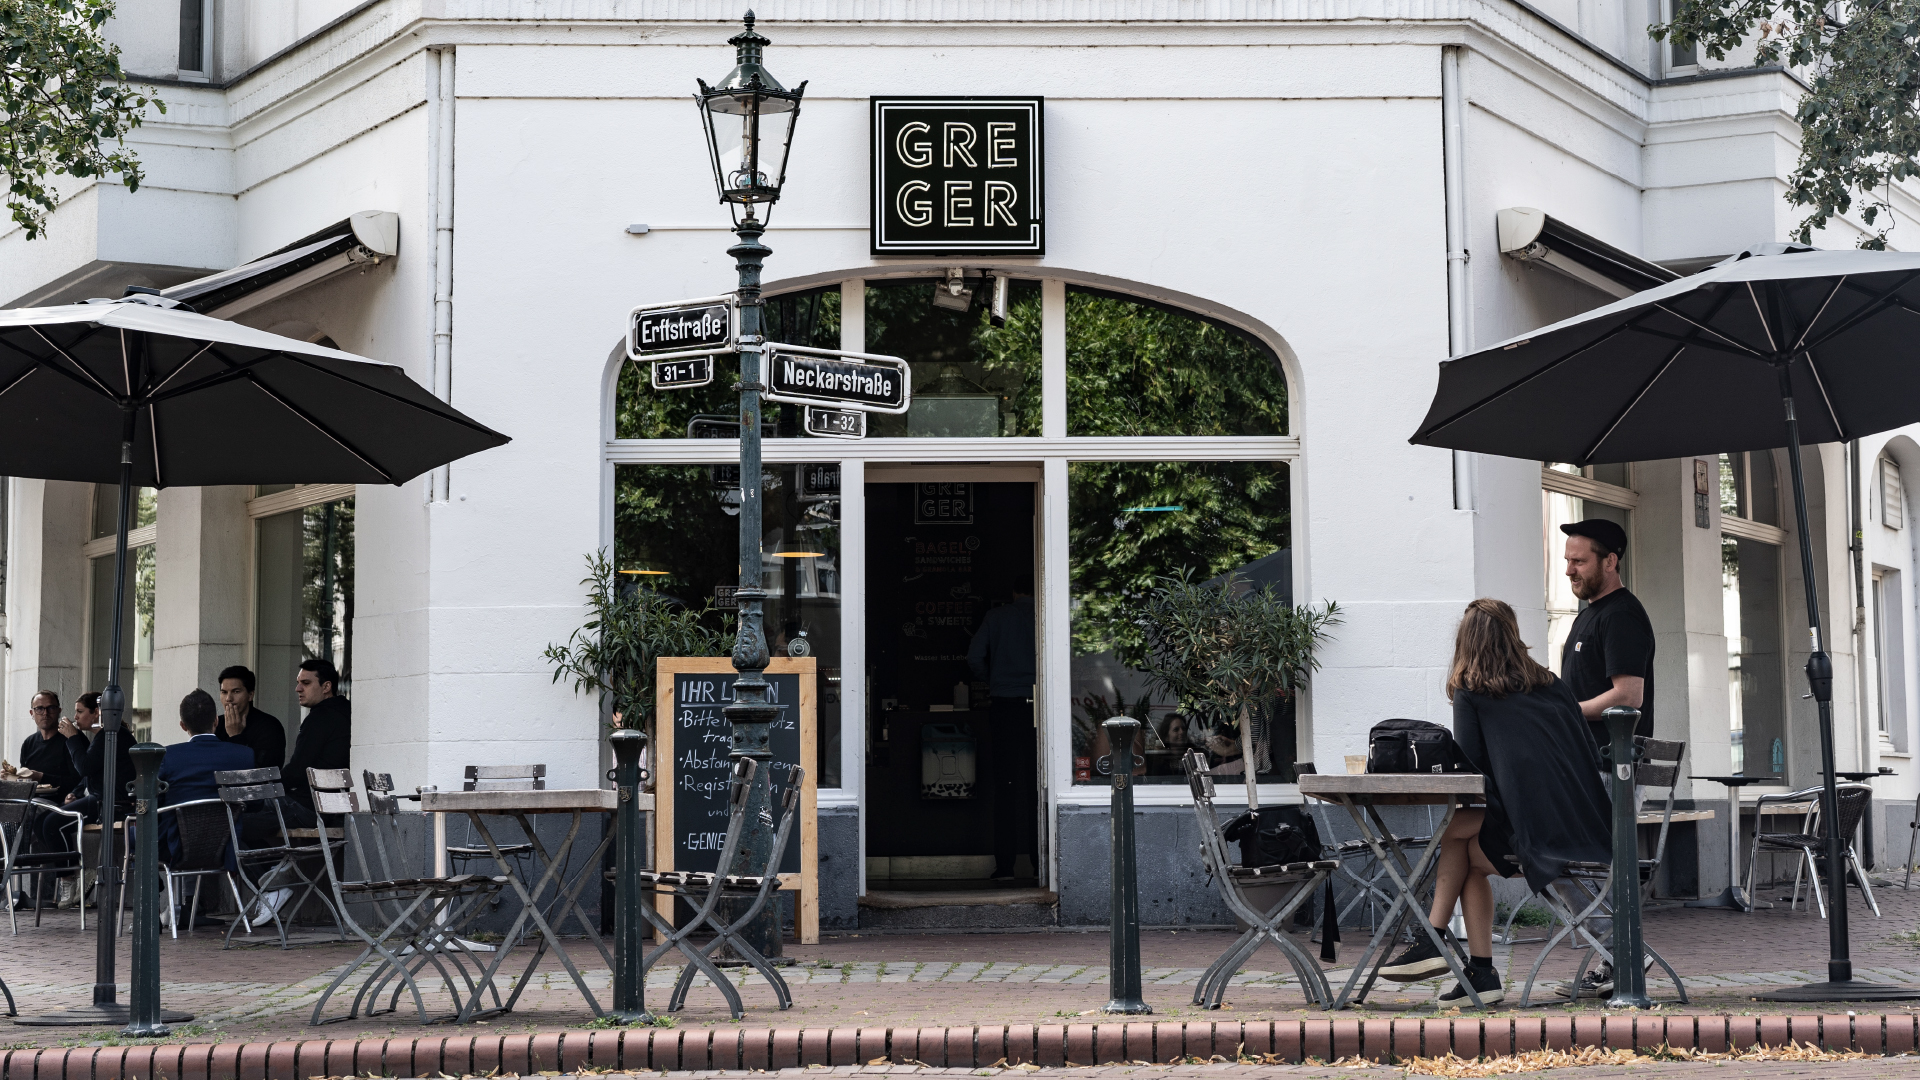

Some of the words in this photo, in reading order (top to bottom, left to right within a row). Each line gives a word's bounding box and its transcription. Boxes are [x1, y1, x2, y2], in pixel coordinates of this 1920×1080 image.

[895, 121, 1018, 169] GRE
[895, 179, 1019, 228] GER
[641, 313, 722, 344] Erftstraße
[783, 361, 892, 396] Neckarstraße
[922, 499, 966, 517] GER
[915, 556, 972, 564] SANDWICHES
[717, 597, 737, 607] GER
[915, 601, 973, 614] COFFEE
[915, 616, 924, 626] &
[927, 616, 973, 626] SWEETS
[914, 654, 938, 662] Wasser
[681, 680, 715, 703] IHR
[721, 681, 779, 703] LIN
[683, 709, 720, 728] Bitte
[703, 729, 733, 748] trag
[683, 748, 731, 769] Abstan
[708, 800, 729, 817] und
